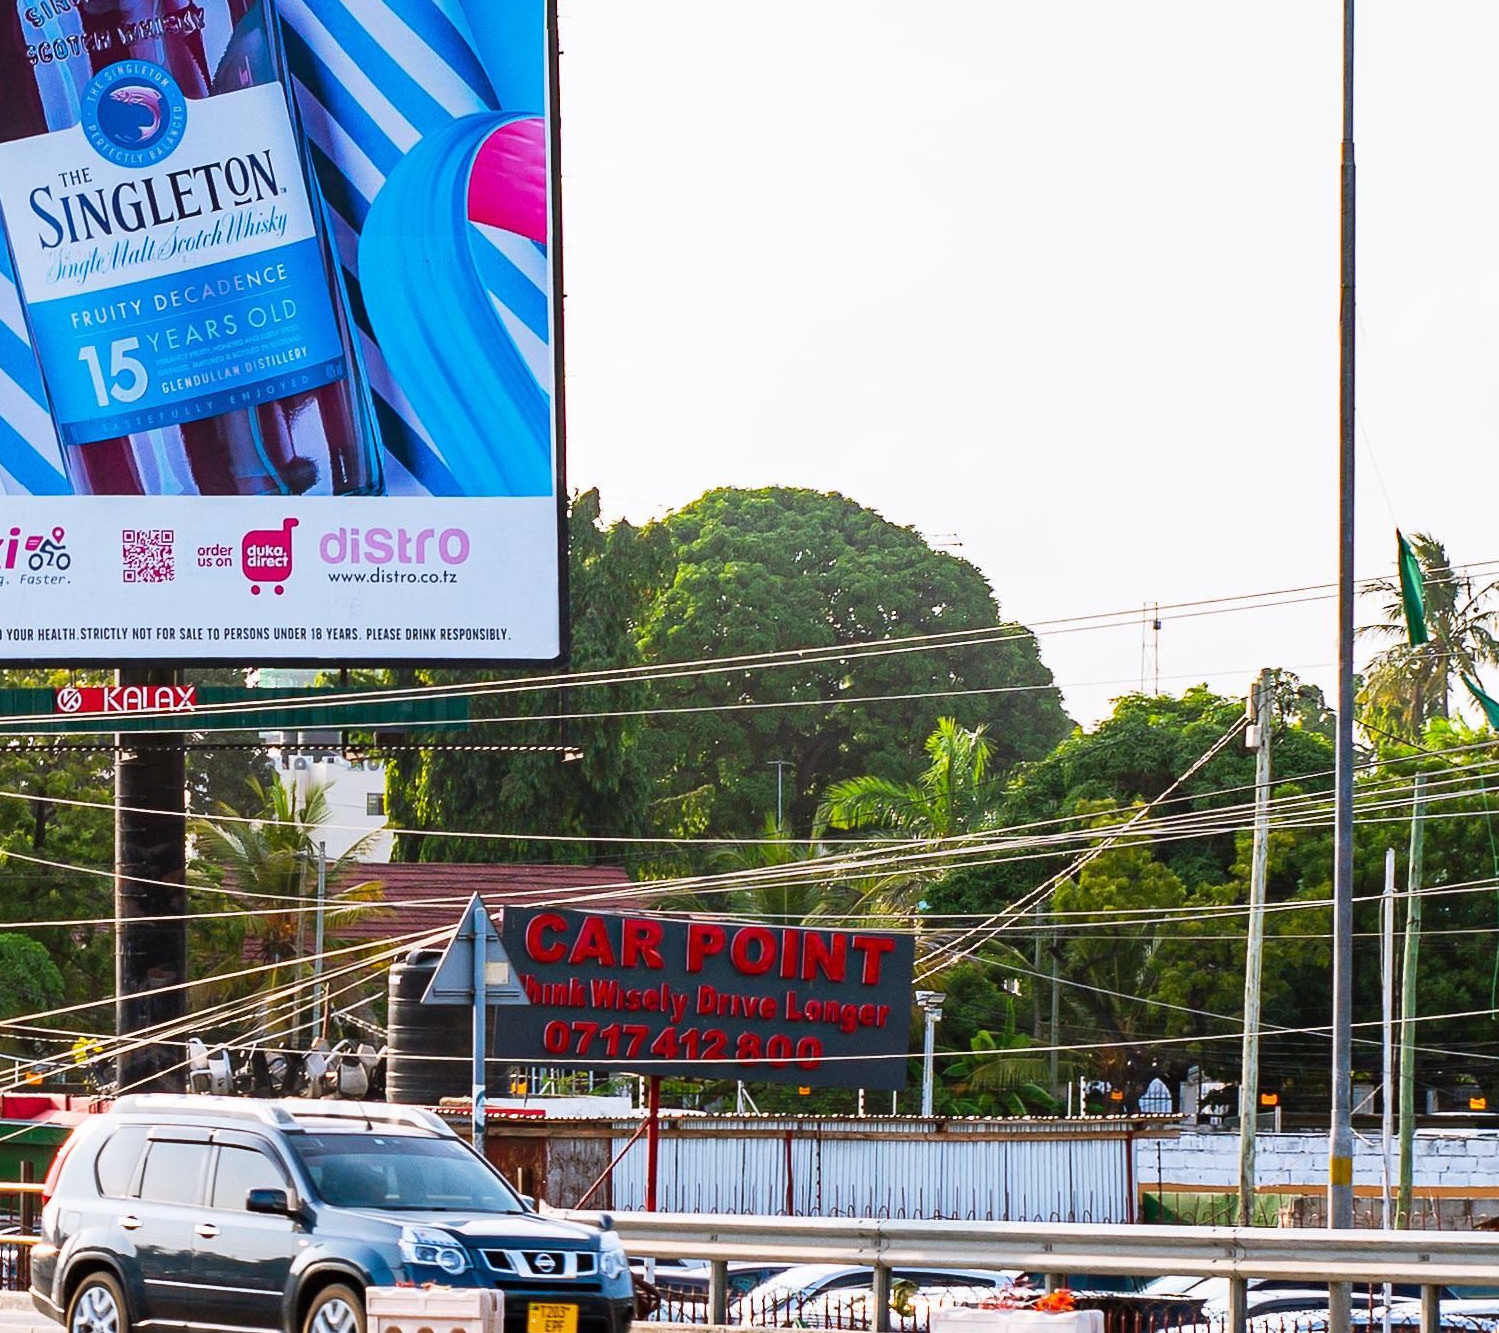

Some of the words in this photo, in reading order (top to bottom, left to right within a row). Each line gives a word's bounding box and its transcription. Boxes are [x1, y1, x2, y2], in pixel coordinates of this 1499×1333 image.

[26, 30, 112, 66] SCOTCH
[86, 81, 104, 102] THE
[104, 64, 170, 87] SINGLETON
[87, 124, 144, 164] PERFECTLY
[149, 106, 183, 161] BALANCED
[58, 167, 92, 188] THE
[29, 149, 280, 250] SINGLETON
[47, 247, 104, 287] Single
[104, 233, 156, 273] Malt
[156, 219, 221, 261] Scotch
[221, 205, 288, 243] Whisky
[71, 299, 142, 329] FRUITY
[154, 264, 287, 311] DECADENCE
[78, 337, 148, 407] 15
[146, 315, 237, 353] YEARS
[248, 299, 297, 327] OLD
[161, 364, 240, 394] GLENDULLAN
[245, 346, 308, 372] DISTILLERY
[230, 375, 309, 405] ENJOYED
[197, 543, 233, 557] order
[197, 557, 212, 567] us
[215, 557, 232, 567] on
[246, 555, 289, 568] direct
[20, 573, 71, 585] Faster.
[328, 567, 457, 584] www.distro.co.tz
[6, 628, 33, 642] YOUR
[132, 628, 152, 642] NOT
[156, 628, 175, 642] FOR
[180, 628, 203, 642] SALE
[207, 628, 220, 642] TO
[224, 628, 270, 642] PERSONS
[273, 628, 307, 642] UNDER
[311, 628, 322, 642] 18
[326, 628, 361, 642] YEARS.
[366, 628, 401, 642] PLEASE
[405, 628, 436, 642] DRINK
[440, 628, 511, 642] RESPONSIBLY.
[525, 913, 665, 969] CAR
[686, 923, 896, 986] POINT
[590, 978, 688, 1024] Wisely
[697, 984, 778, 1020] Drive
[785, 991, 891, 1034] Longer
